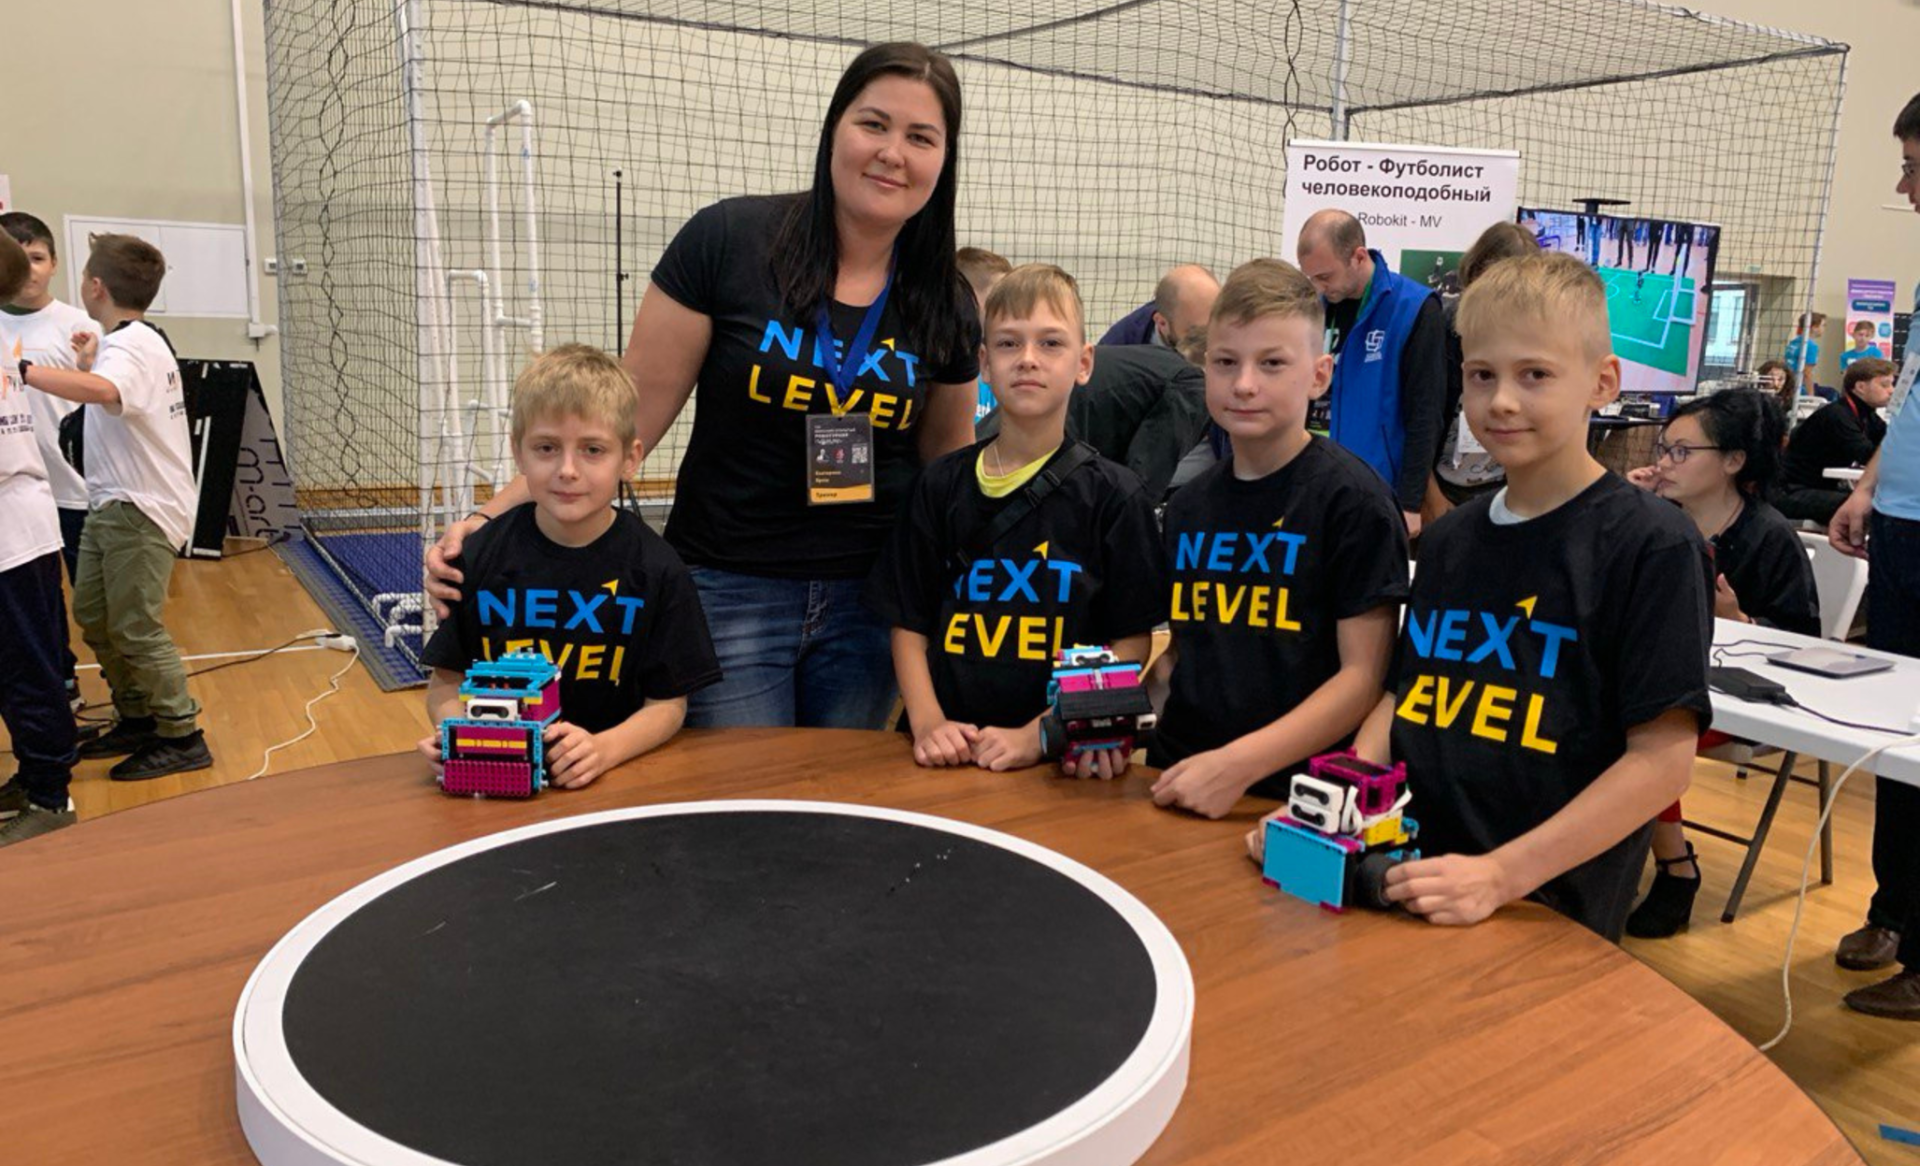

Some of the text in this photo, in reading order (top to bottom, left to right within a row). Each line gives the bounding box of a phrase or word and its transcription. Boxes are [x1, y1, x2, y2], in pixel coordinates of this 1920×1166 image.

[1303, 154, 1361, 173] Робот
[1379, 157, 1484, 179] Футболист
[1302, 181, 1491, 202] человекоподобный
[1358, 212, 1408, 227] Robokit
[1420, 215, 1442, 228] MV
[759, 320, 919, 387] NEXT
[749, 364, 913, 430] LEVEL
[1175, 531, 1307, 575] NEXT
[954, 558, 1082, 603] EXT
[476, 588, 644, 635] NEXT
[1171, 581, 1301, 631] LEVEL
[482, 637, 626, 685] VEL
[944, 613, 1064, 661] EVEL
[1407, 608, 1578, 679] NEXT
[1396, 674, 1558, 755] EVEL
